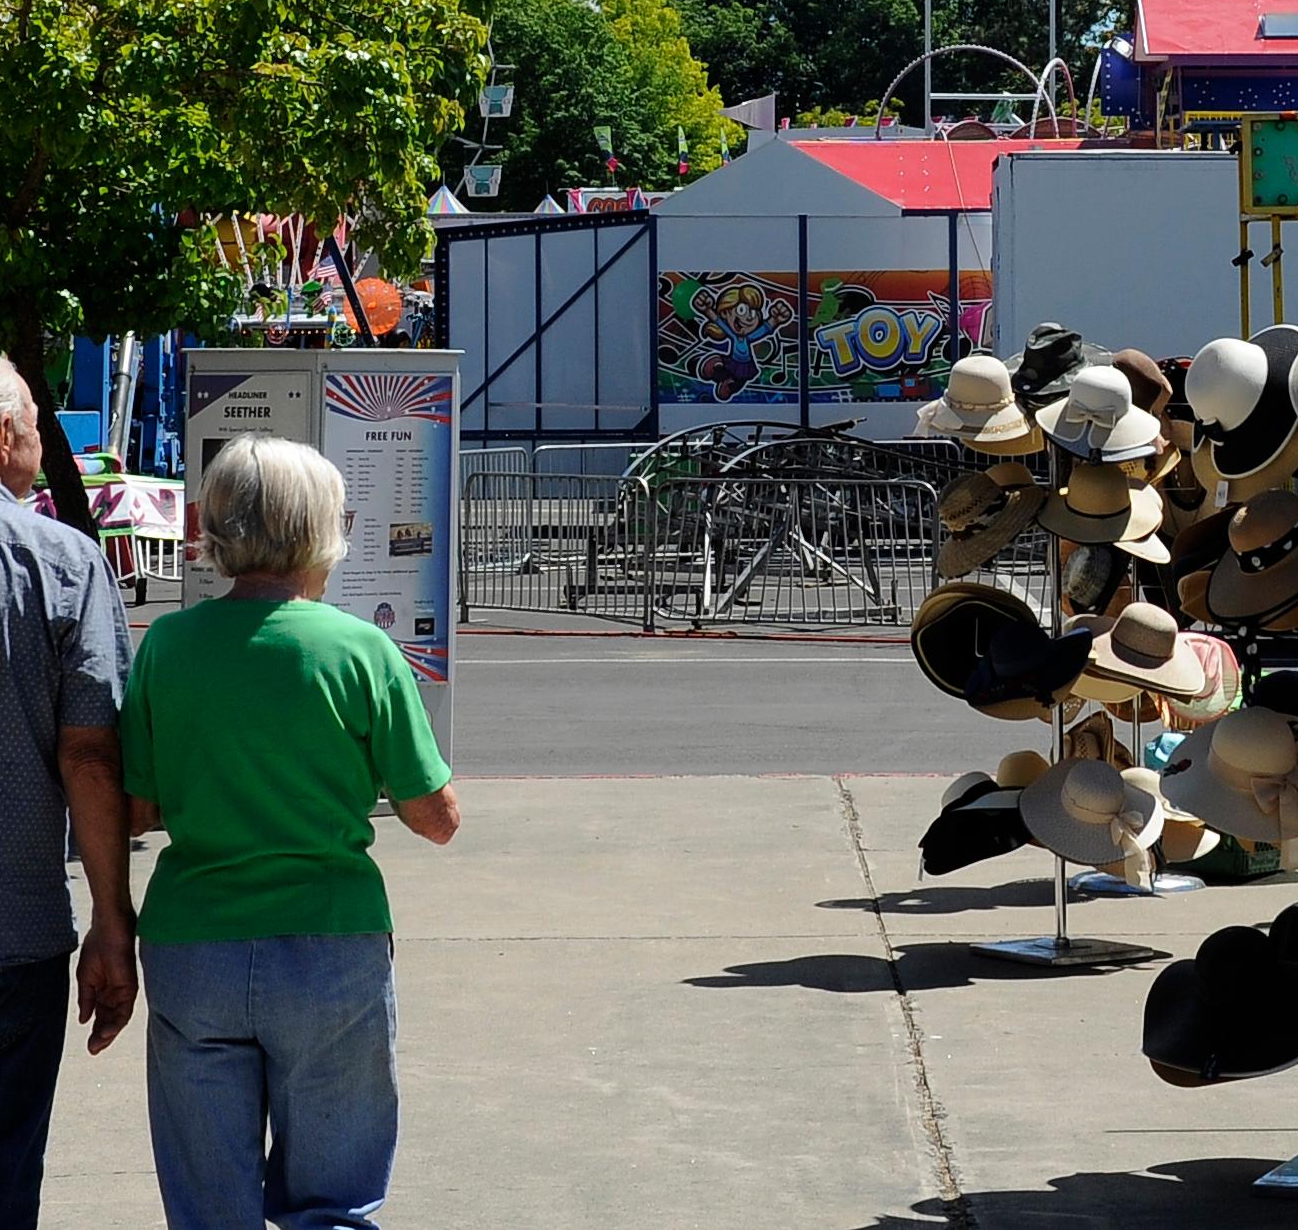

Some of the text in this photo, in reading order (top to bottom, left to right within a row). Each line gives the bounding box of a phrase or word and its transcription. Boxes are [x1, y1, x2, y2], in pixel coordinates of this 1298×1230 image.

[815, 305, 942, 374] TOY
[224, 406, 271, 418] SEETHER
[366, 431, 412, 441] FREE FUN
